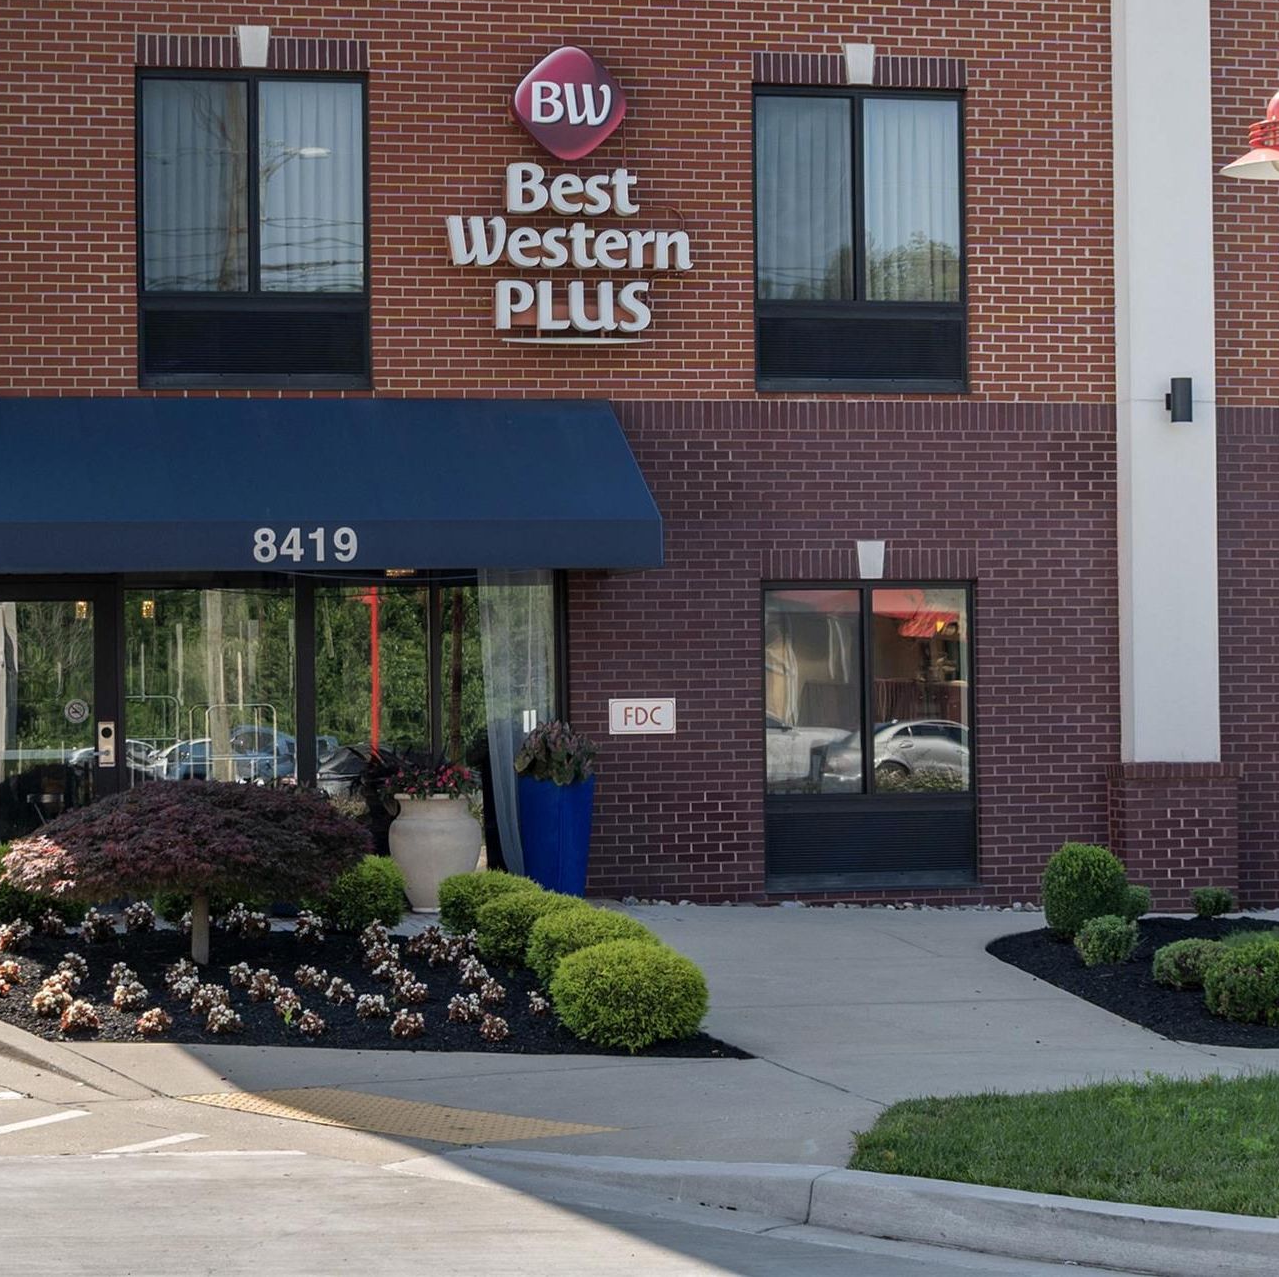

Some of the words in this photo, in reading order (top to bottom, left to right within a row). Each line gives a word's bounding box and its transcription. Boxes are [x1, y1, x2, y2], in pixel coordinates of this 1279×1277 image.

[531, 81, 612, 126] BW
[506, 162, 640, 216] Best
[446, 215, 694, 270] Western
[495, 279, 651, 333] PLUS
[253, 527, 358, 563] 8419
[624, 706, 661, 726] FDC
